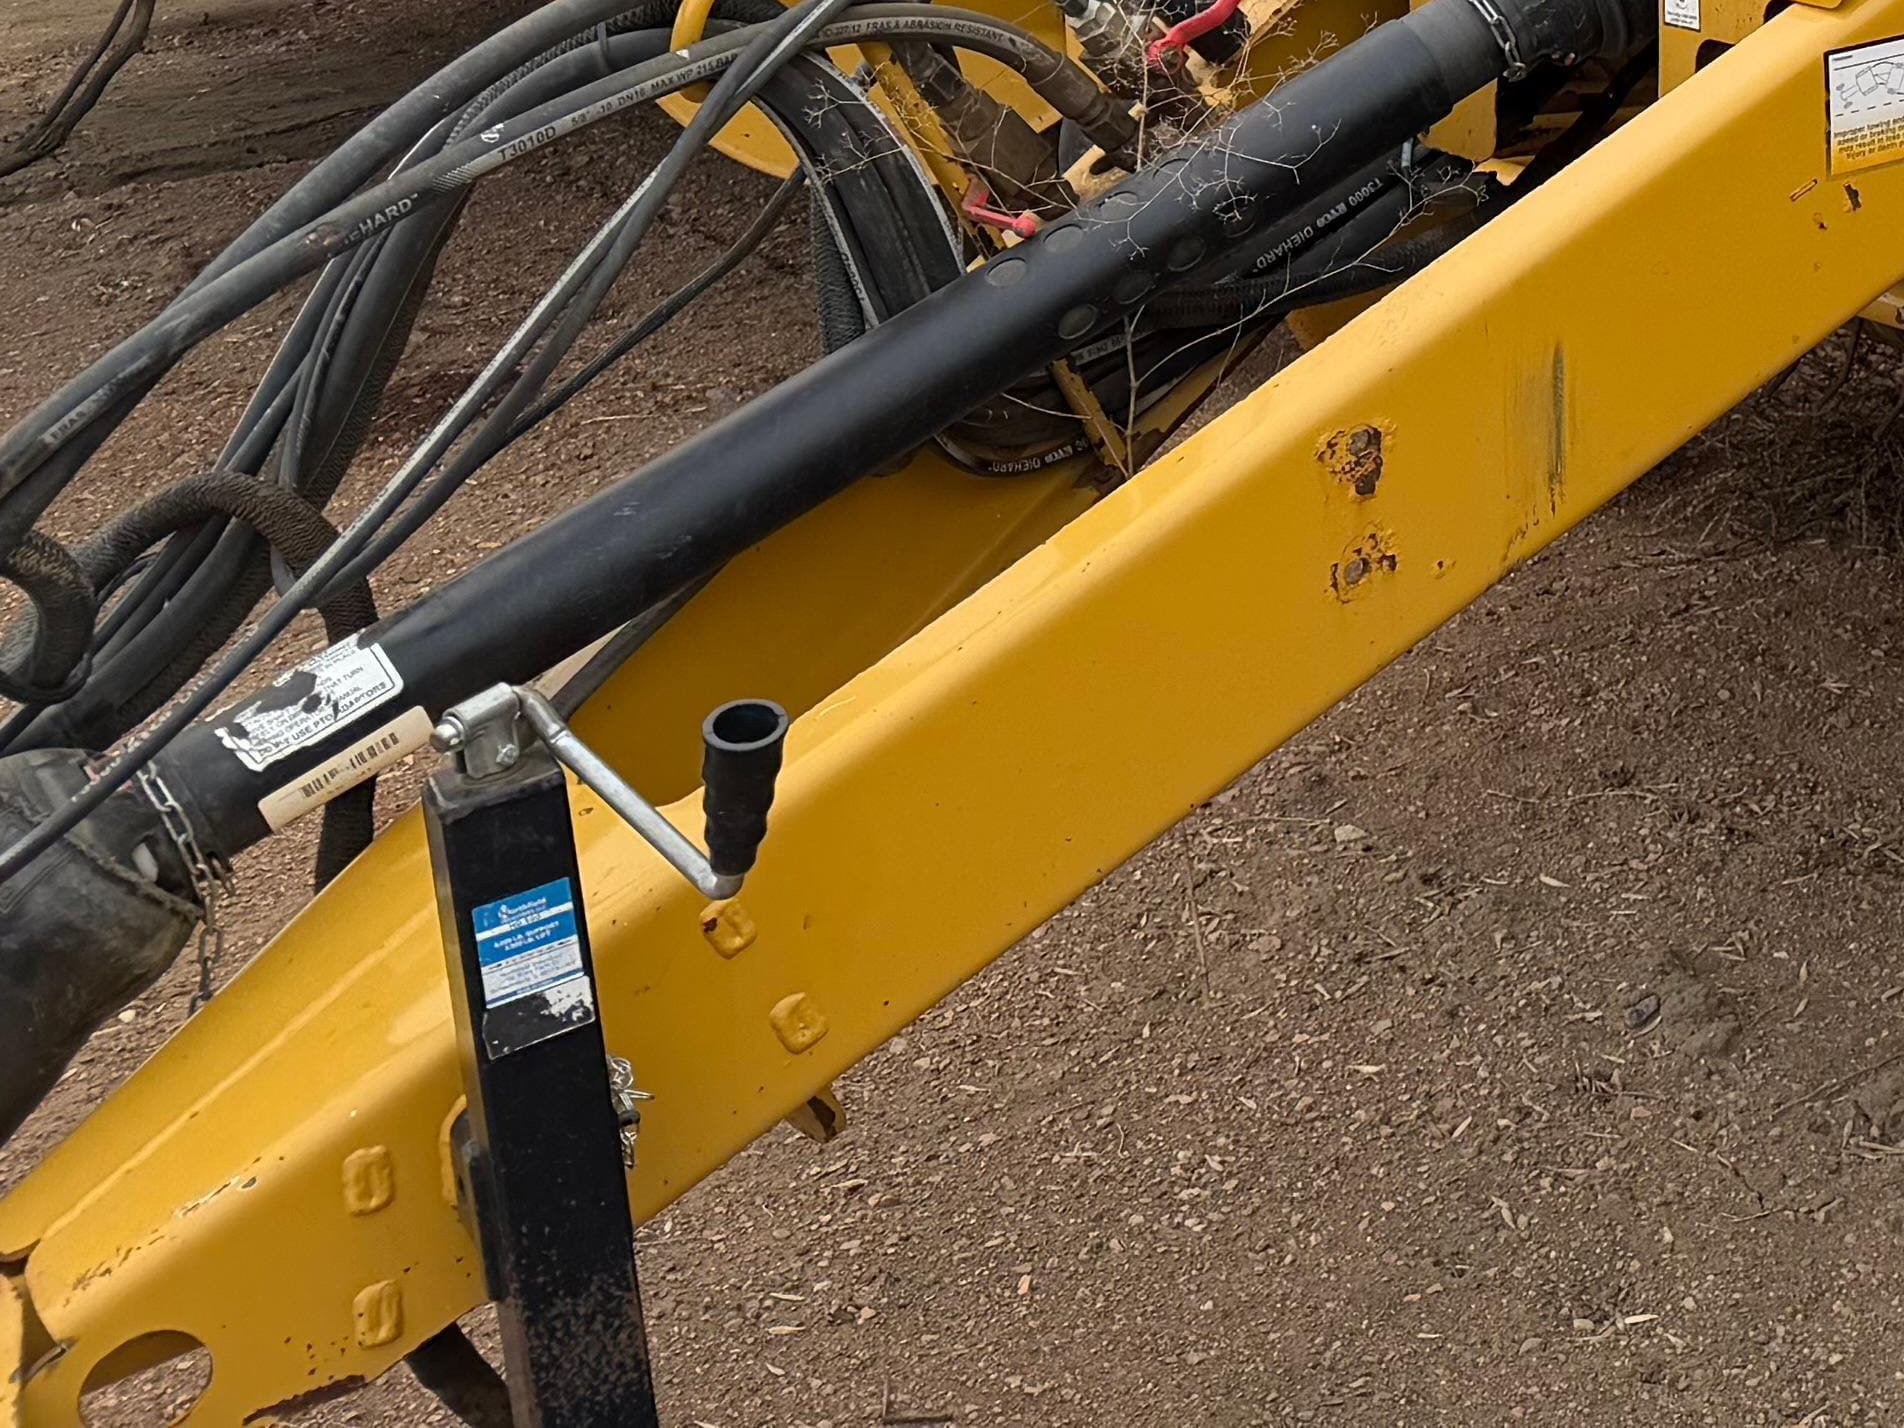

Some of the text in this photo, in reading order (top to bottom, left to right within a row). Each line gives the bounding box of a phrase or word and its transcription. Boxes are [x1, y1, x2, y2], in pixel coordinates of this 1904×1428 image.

[497, 126, 557, 162] T3010D
[1255, 224, 1315, 274] DIEHARD
[292, 727, 312, 741] USE
[313, 716, 334, 730] PTO
